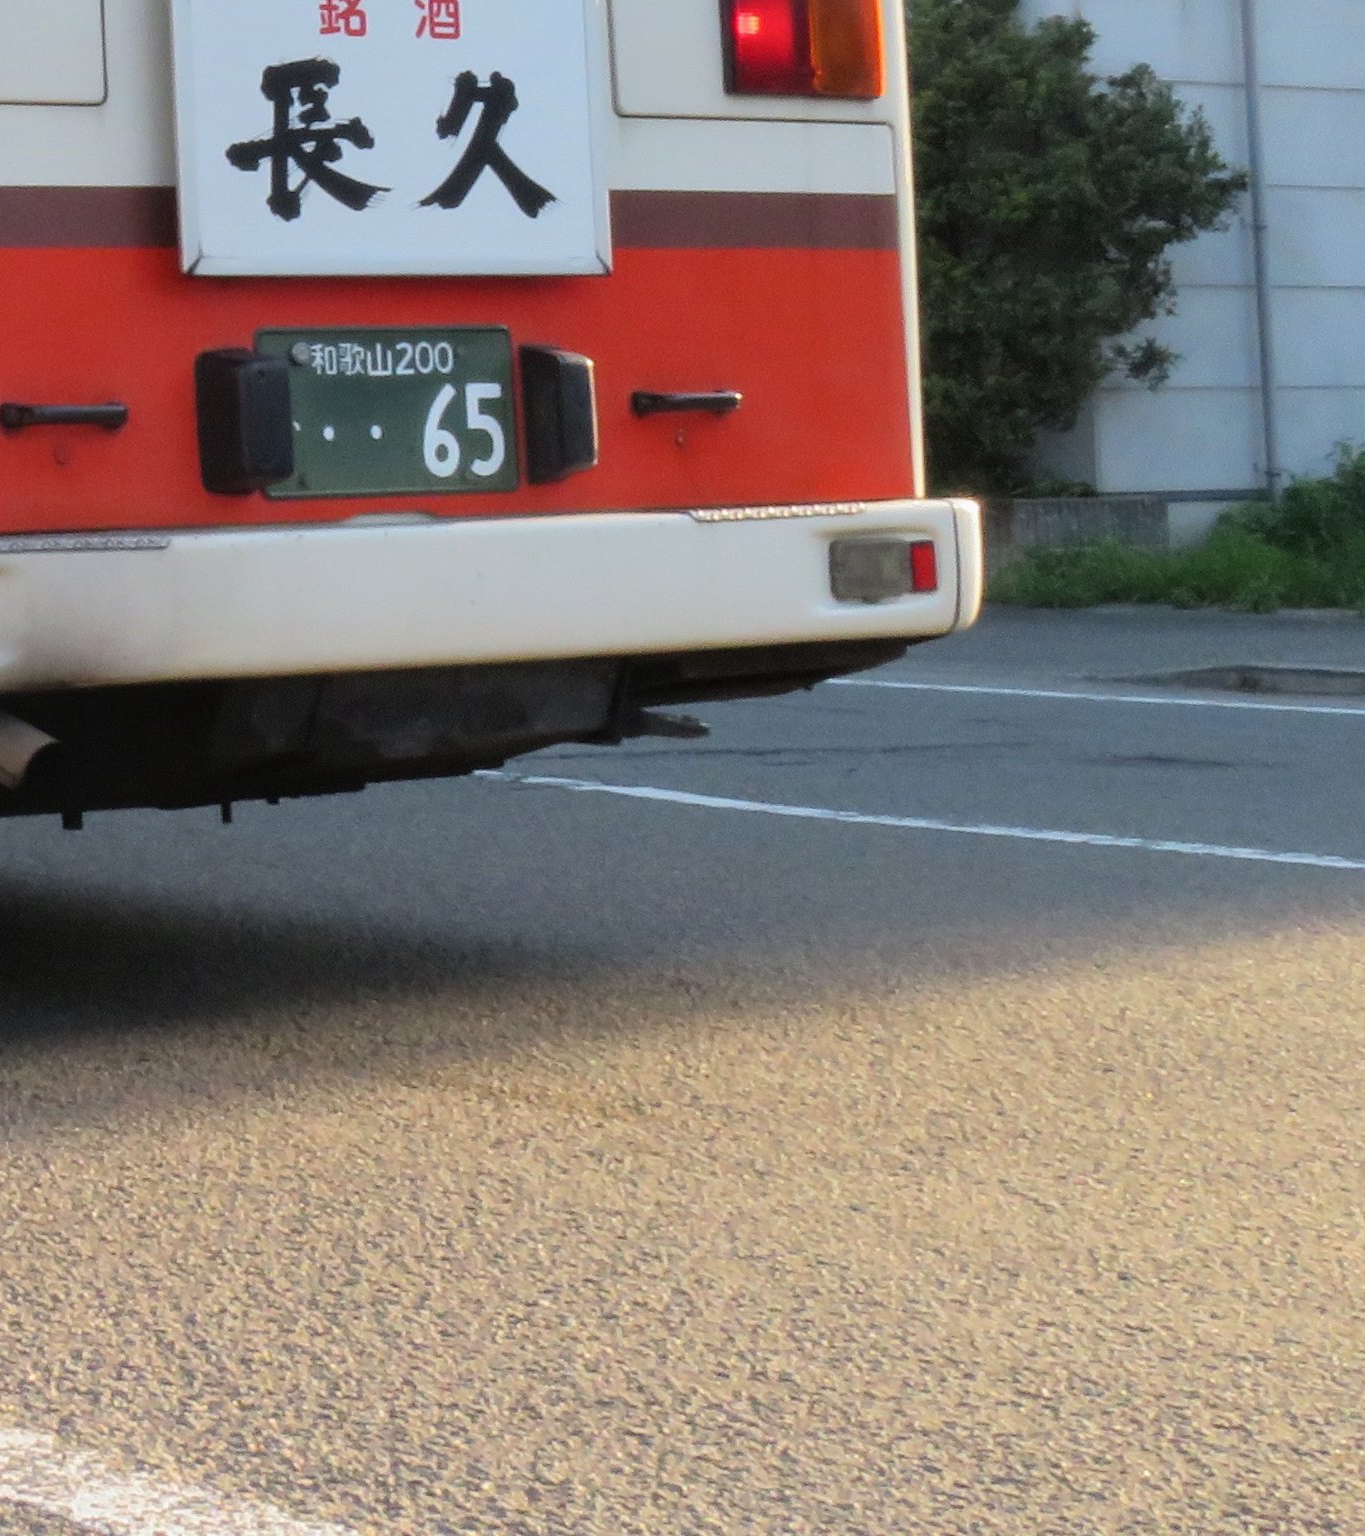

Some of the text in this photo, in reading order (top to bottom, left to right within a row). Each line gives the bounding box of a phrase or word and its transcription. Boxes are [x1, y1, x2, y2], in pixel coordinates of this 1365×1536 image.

[225, 55, 565, 222] 長久
[310, 341, 454, 376] 和歌山200
